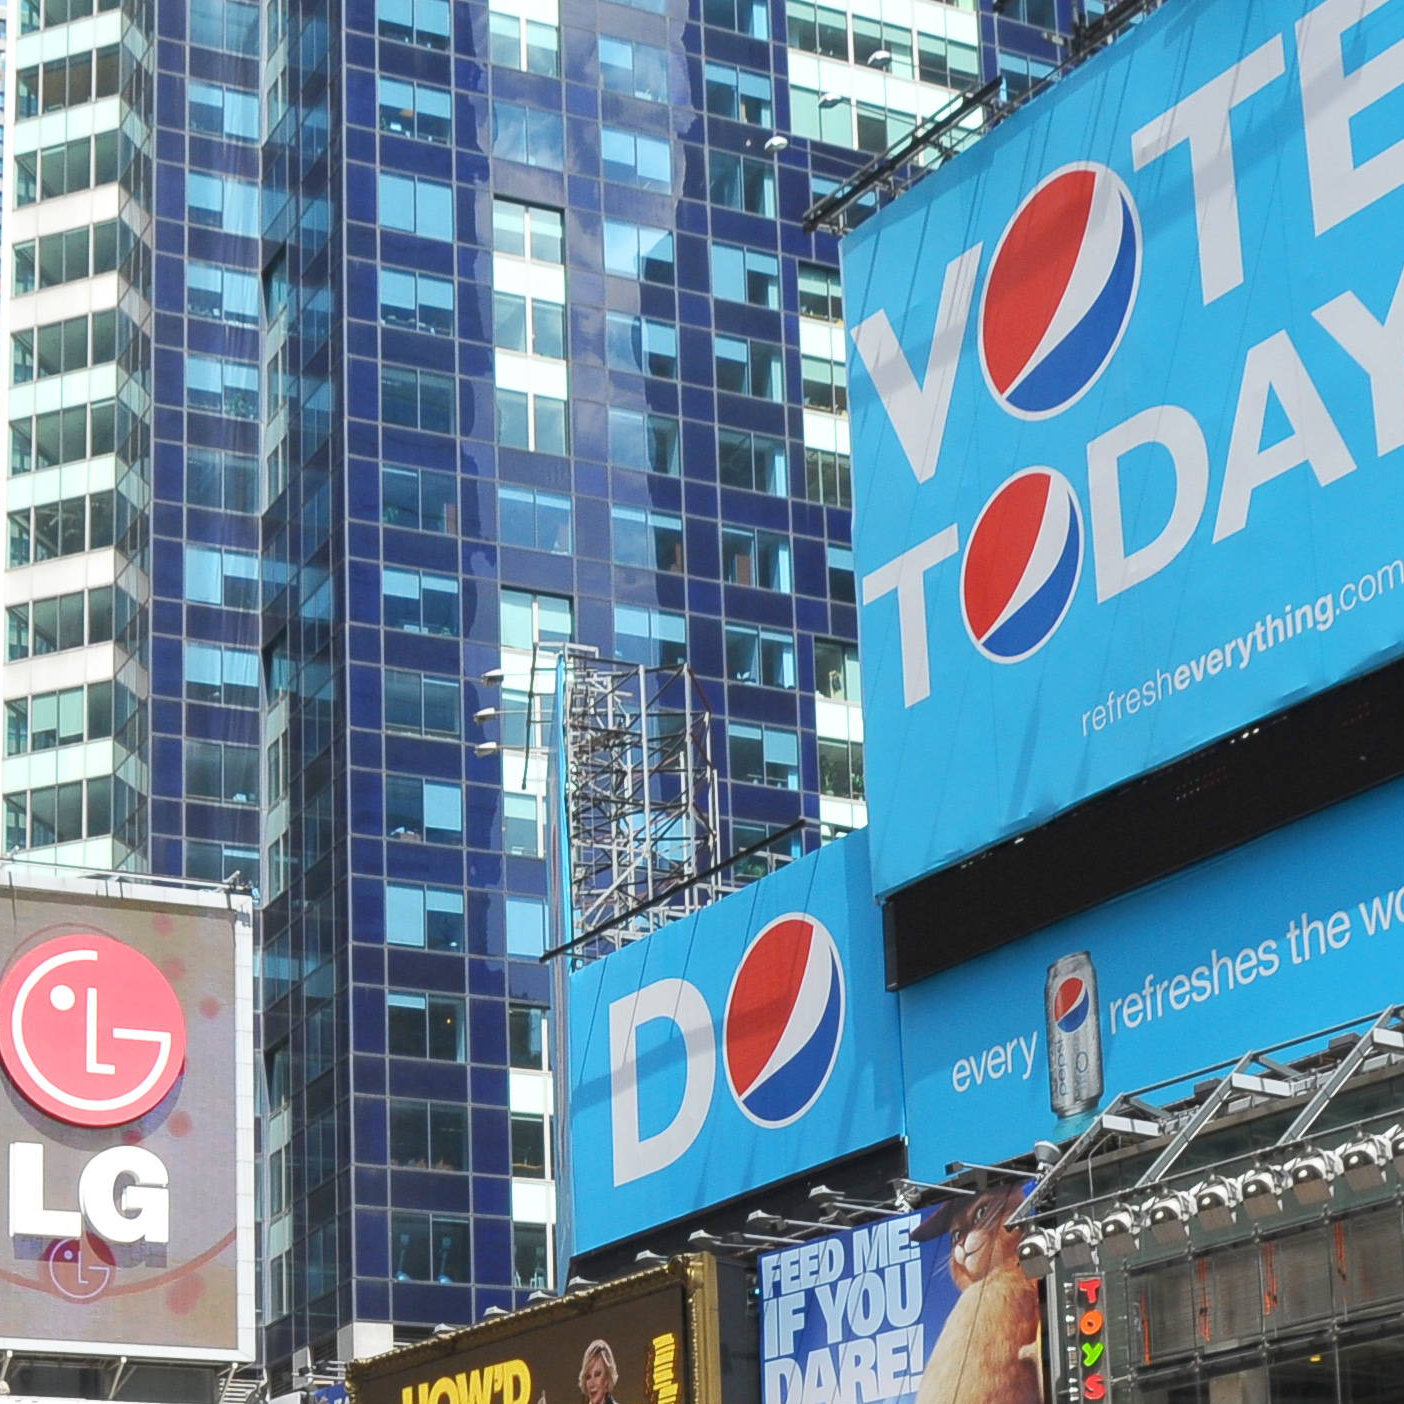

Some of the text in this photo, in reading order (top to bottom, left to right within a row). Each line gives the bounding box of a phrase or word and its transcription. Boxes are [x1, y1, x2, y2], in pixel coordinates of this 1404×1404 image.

[1081, 558, 1404, 737] refresheverything.com
[952, 1031, 1038, 1093] every
[1109, 935, 1280, 1035] refreshes
[1285, 909, 1352, 968] the
[8, 1140, 171, 1246] LG
[762, 1213, 921, 1299] FEED ME!
[764, 1259, 923, 1359] IF YOU
